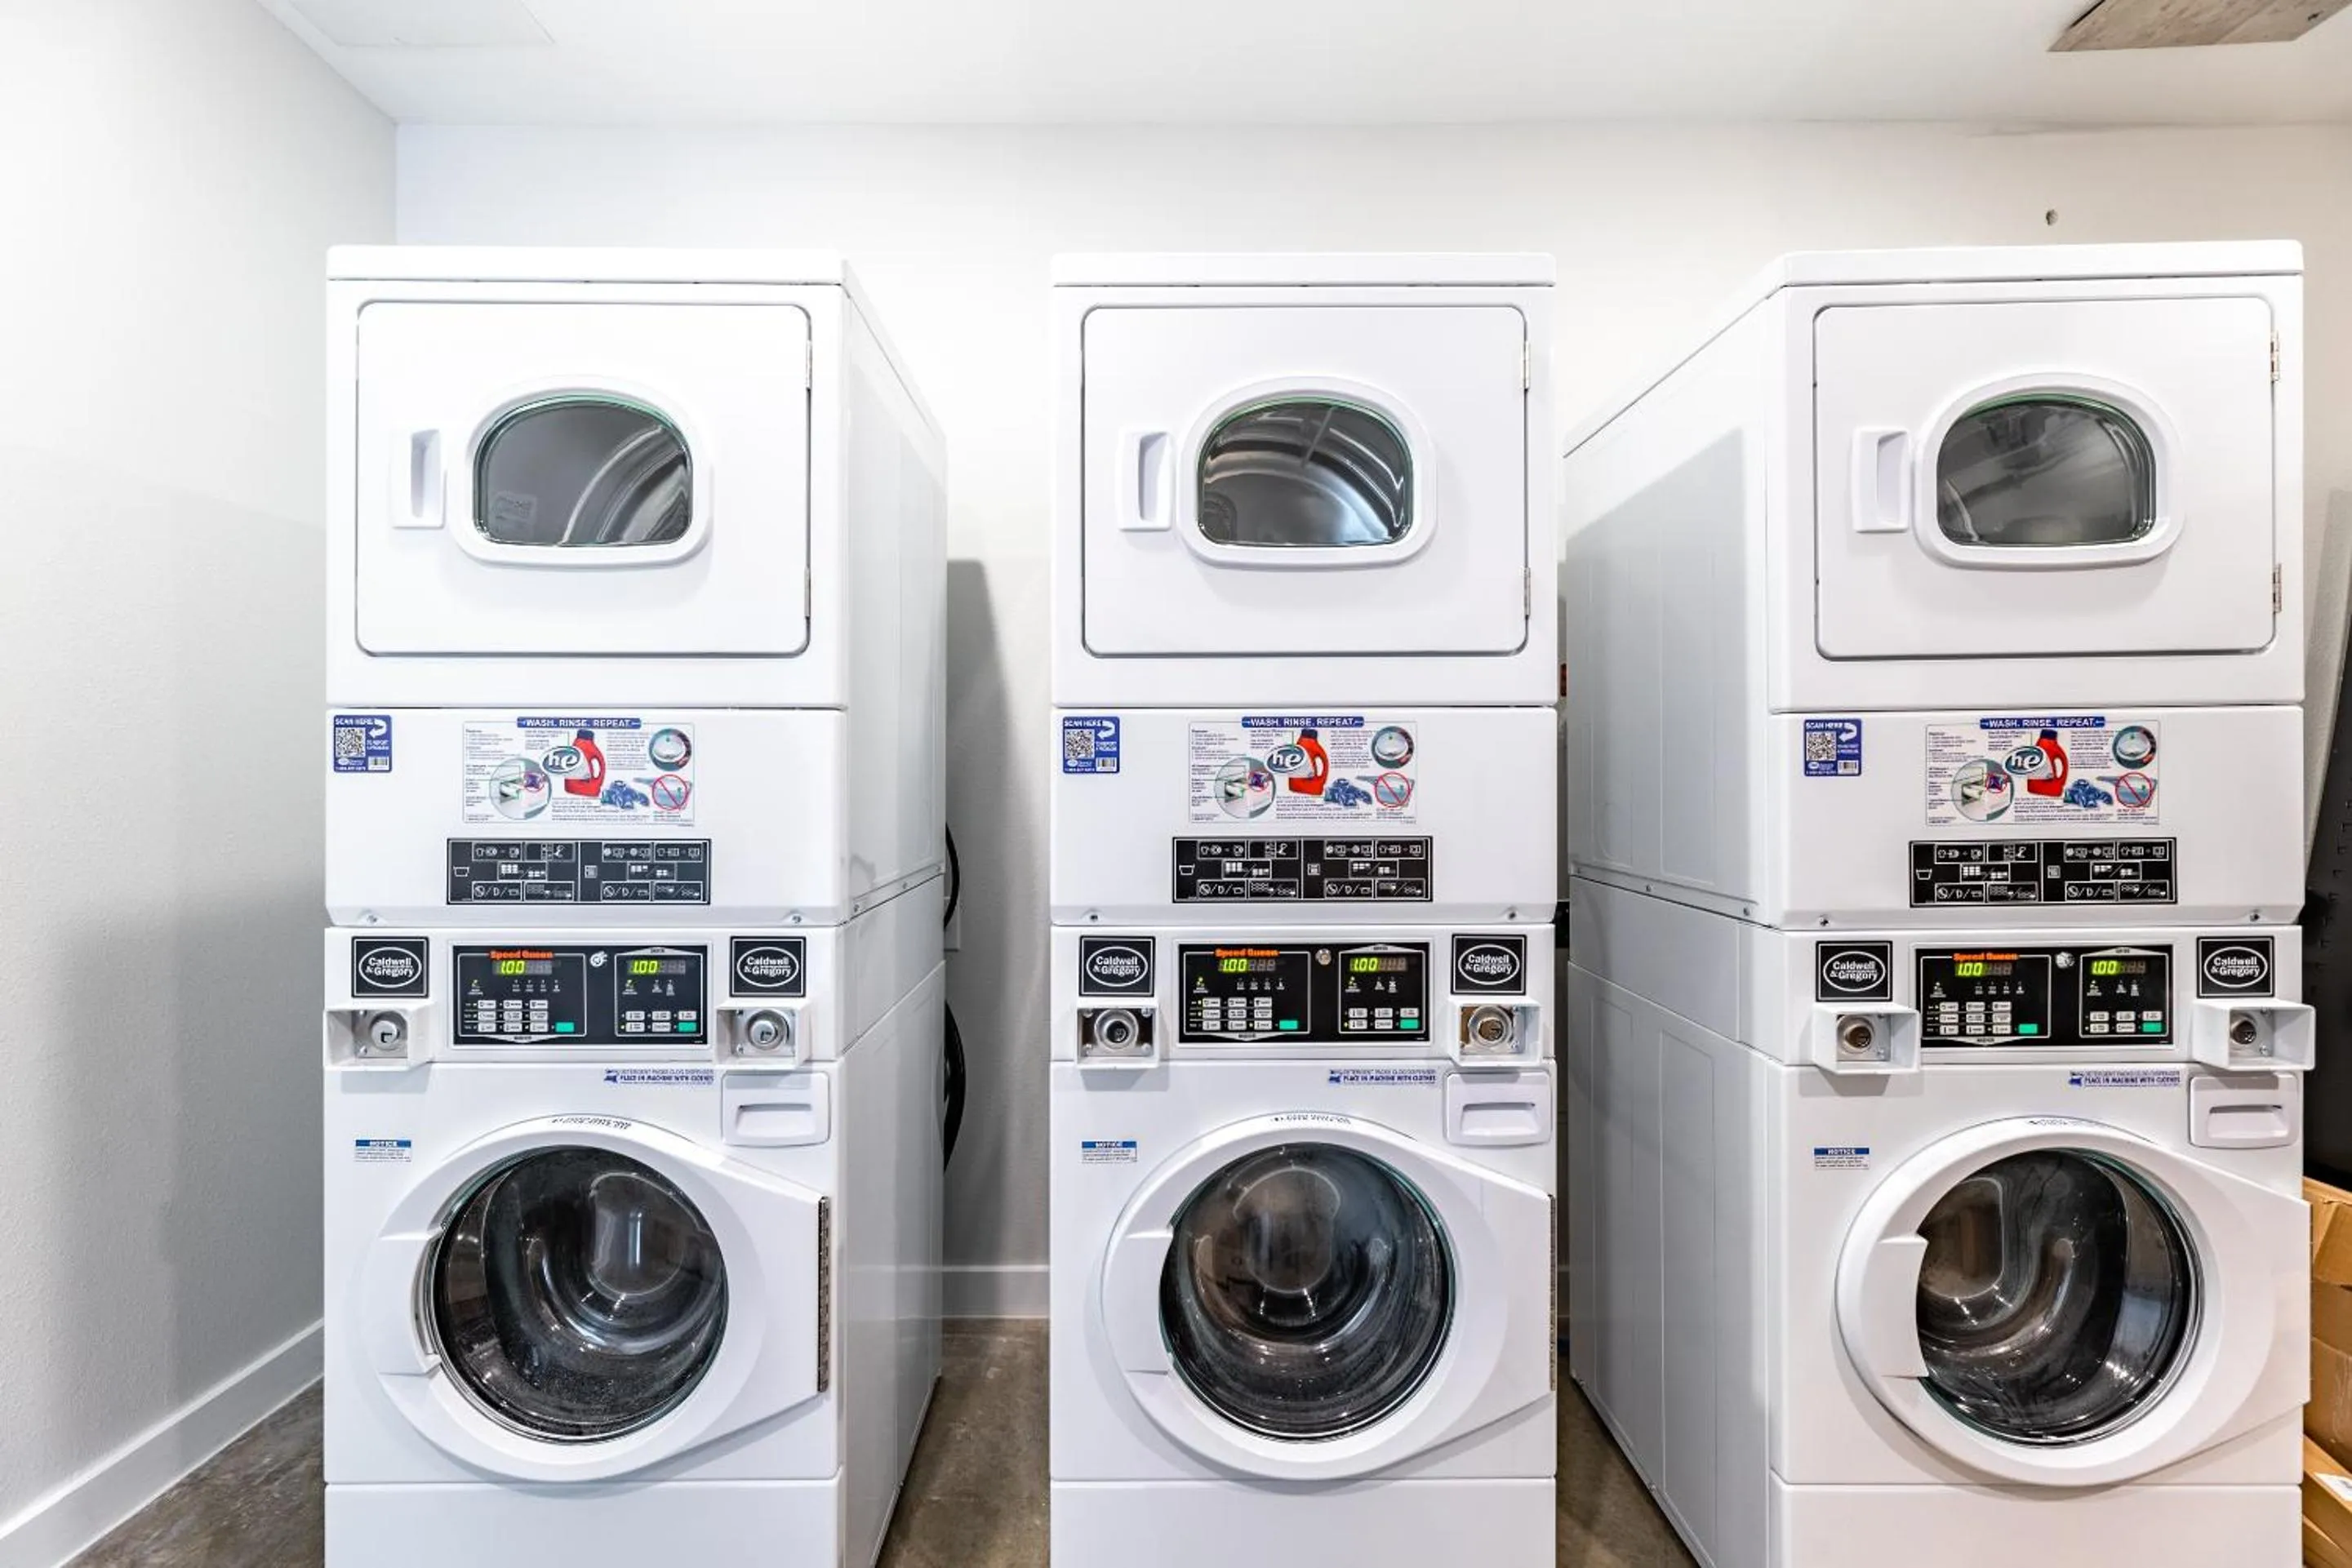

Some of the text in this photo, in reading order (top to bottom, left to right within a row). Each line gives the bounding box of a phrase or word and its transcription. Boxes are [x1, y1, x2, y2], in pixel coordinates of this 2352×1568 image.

[1251, 718, 1280, 726] WASH.
[1283, 718, 1315, 726] RINSE.
[1990, 720, 2020, 728] WASH.
[2022, 719, 2054, 727] RINSE.
[490, 950, 554, 960] Speed Queen
[1215, 948, 1279, 957] Speed Queen
[368, 957, 411, 966] Caldwell
[747, 956, 789, 965] Caldwell
[1096, 956, 1138, 965] Caldwell
[1468, 954, 1509, 963] Caldwell
[1954, 953, 2019, 962] Speed Queen
[2213, 957, 2257, 966] Caldwell
[1833, 961, 1876, 970] Caldwell
